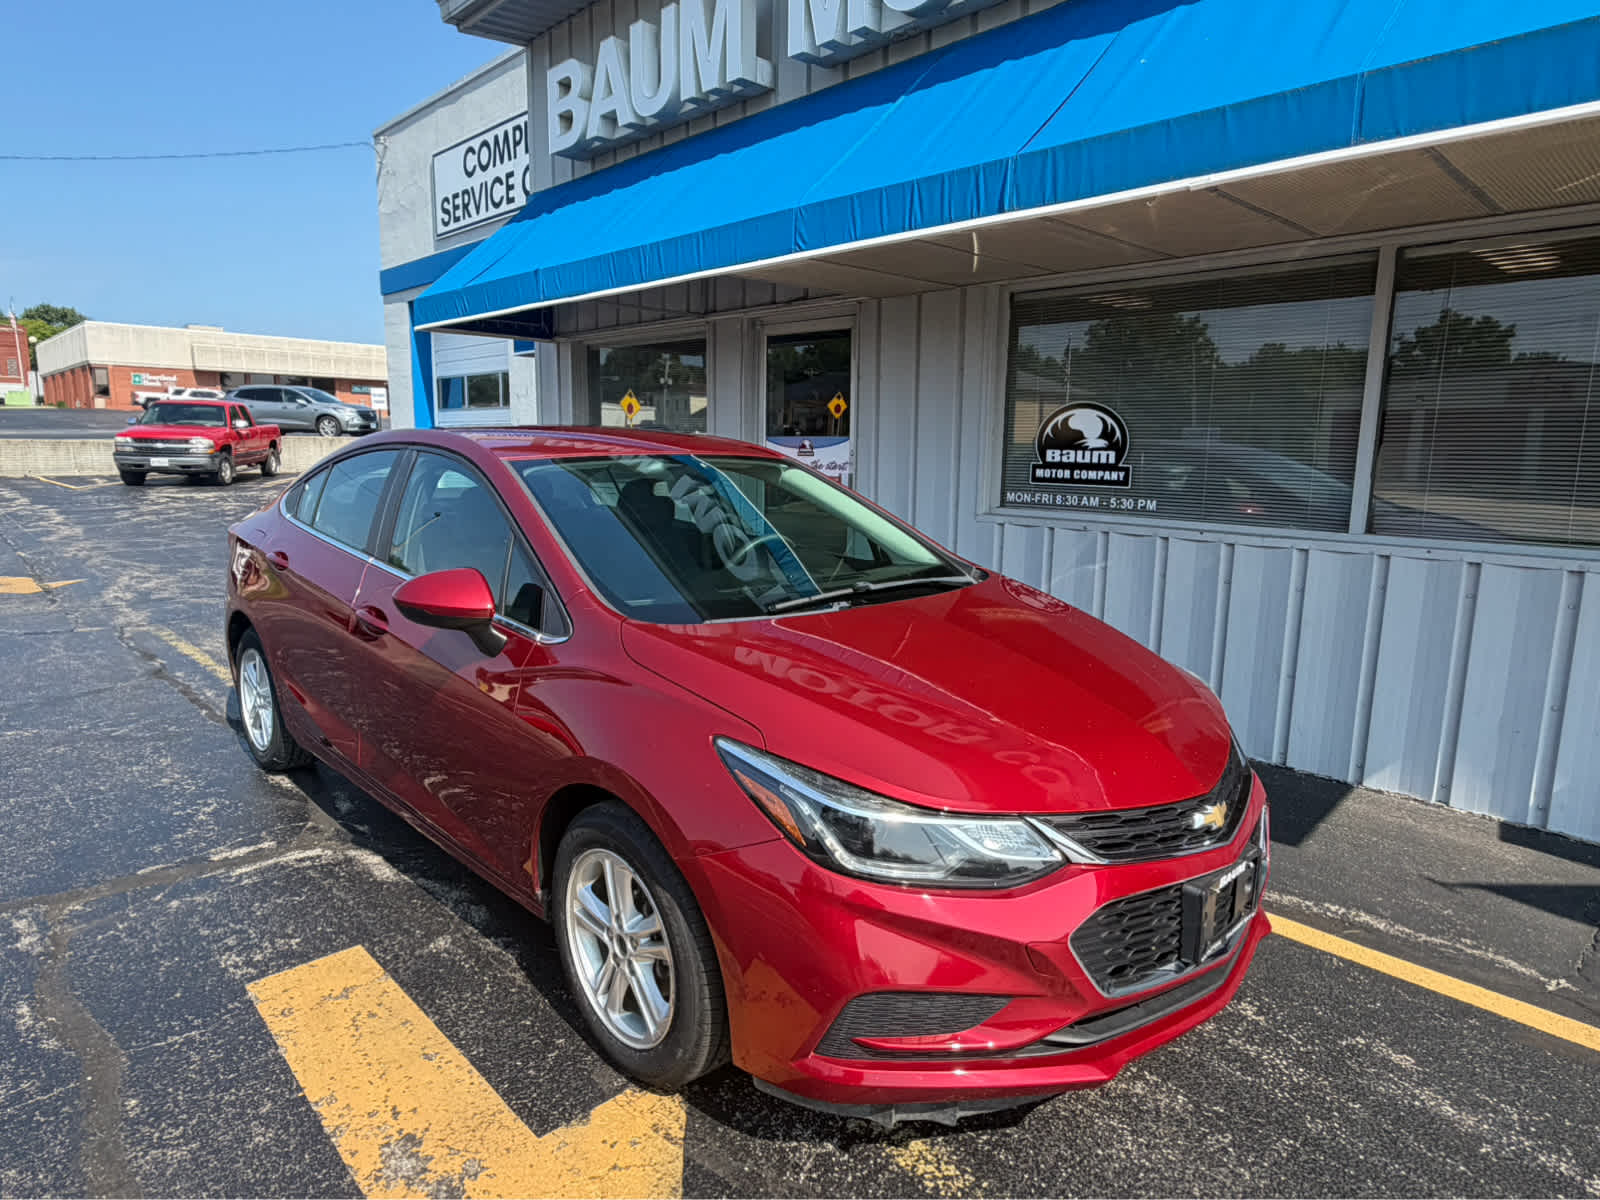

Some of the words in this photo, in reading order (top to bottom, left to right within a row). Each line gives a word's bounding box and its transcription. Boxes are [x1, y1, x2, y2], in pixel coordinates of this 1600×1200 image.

[547, 0, 756, 158] BAUM
[441, 170, 515, 227] SERVICE
[1035, 468, 1071, 479] MOTOR
[1073, 469, 1126, 481] COMPANY
[1006, 491, 1053, 504] MON-FRI
[1055, 494, 1079, 506] 8:30
[1080, 496, 1099, 508] AM
[1109, 496, 1134, 509] 5:30
[1137, 499, 1157, 511] PM
